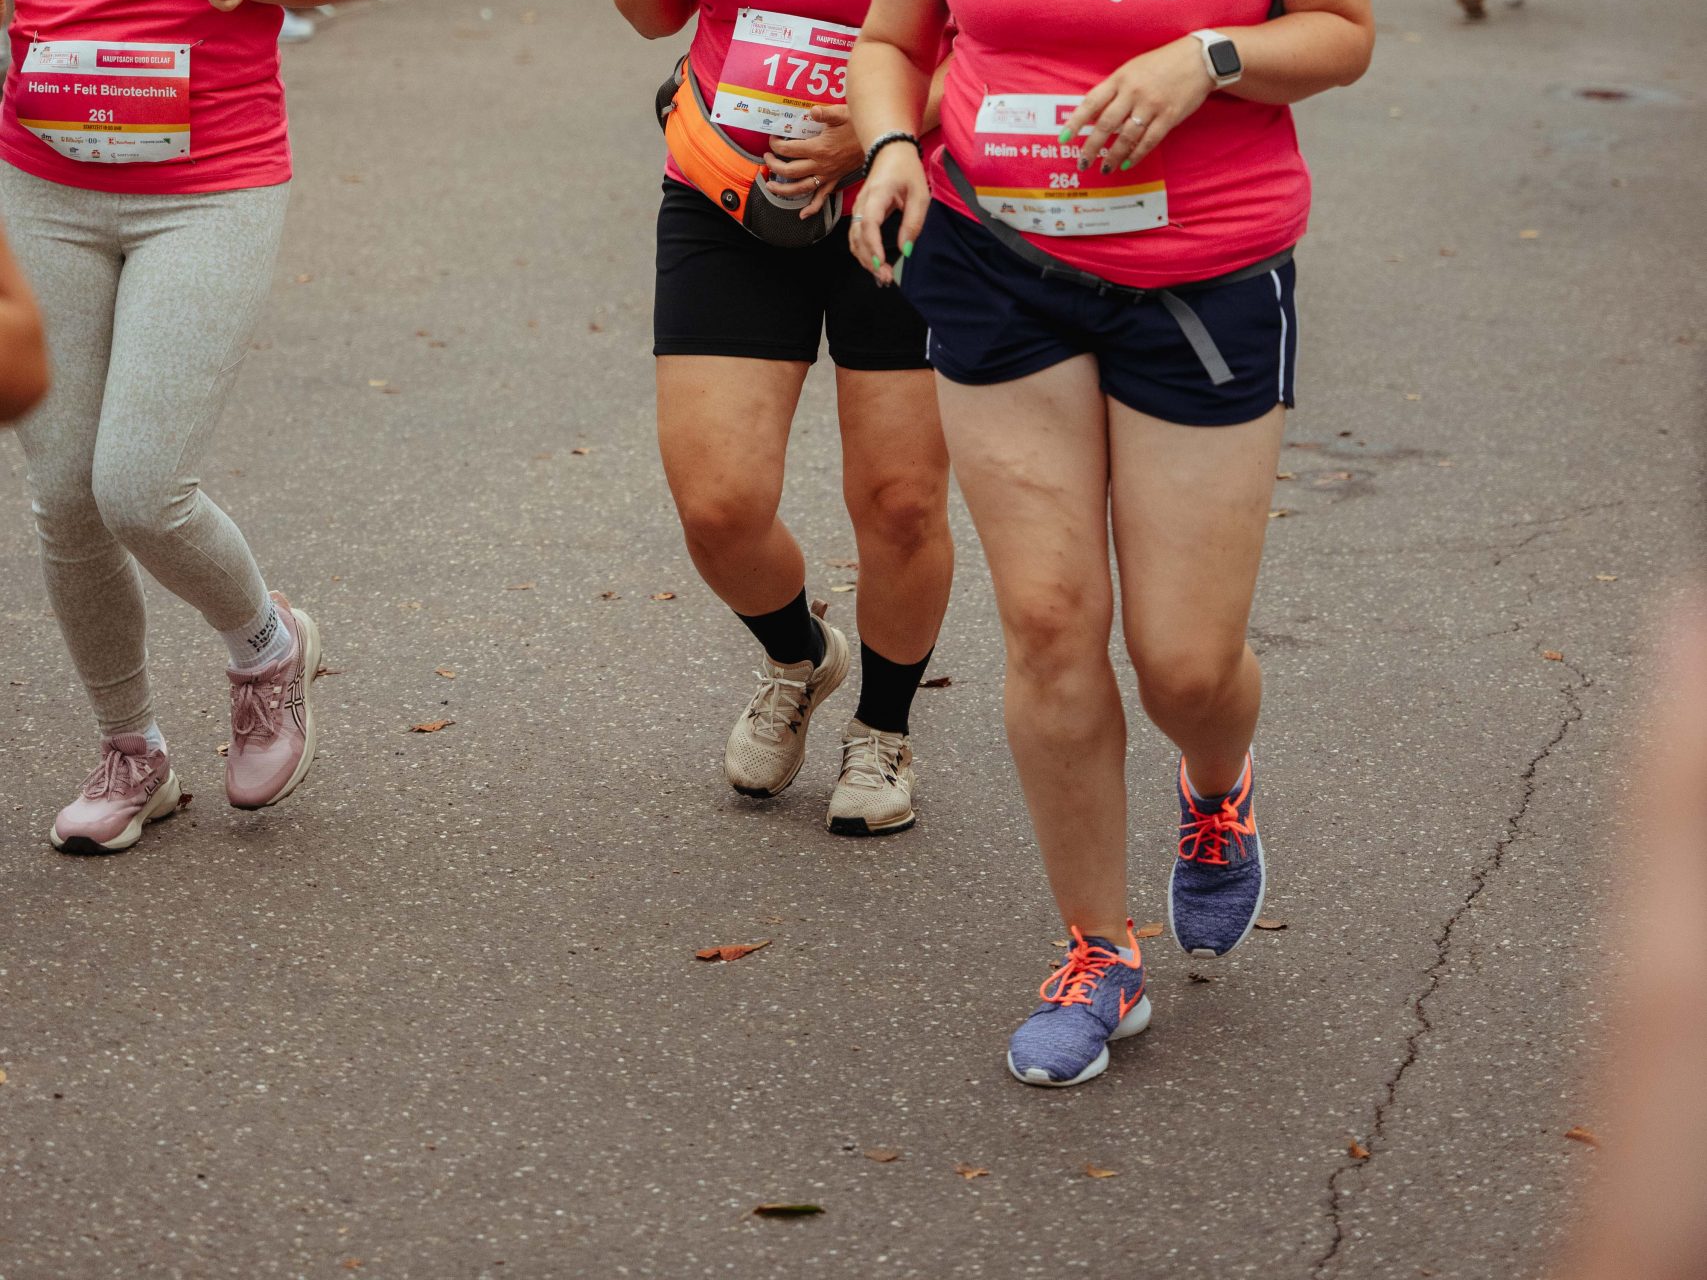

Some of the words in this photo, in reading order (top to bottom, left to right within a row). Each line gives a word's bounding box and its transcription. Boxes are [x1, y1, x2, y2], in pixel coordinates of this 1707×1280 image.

[102, 55, 134, 63] HAUPTSACH
[763, 53, 848, 99] 1753
[28, 81, 60, 94] Heim
[63, 85, 71, 93] +
[74, 83, 98, 96] Feit
[100, 85, 177, 98] Bürotechnik
[736, 101, 749, 109] dm
[89, 108, 114, 122] 261
[984, 143, 1018, 157] Heim
[1031, 143, 1058, 158] Feit
[1049, 172, 1080, 188] 264
